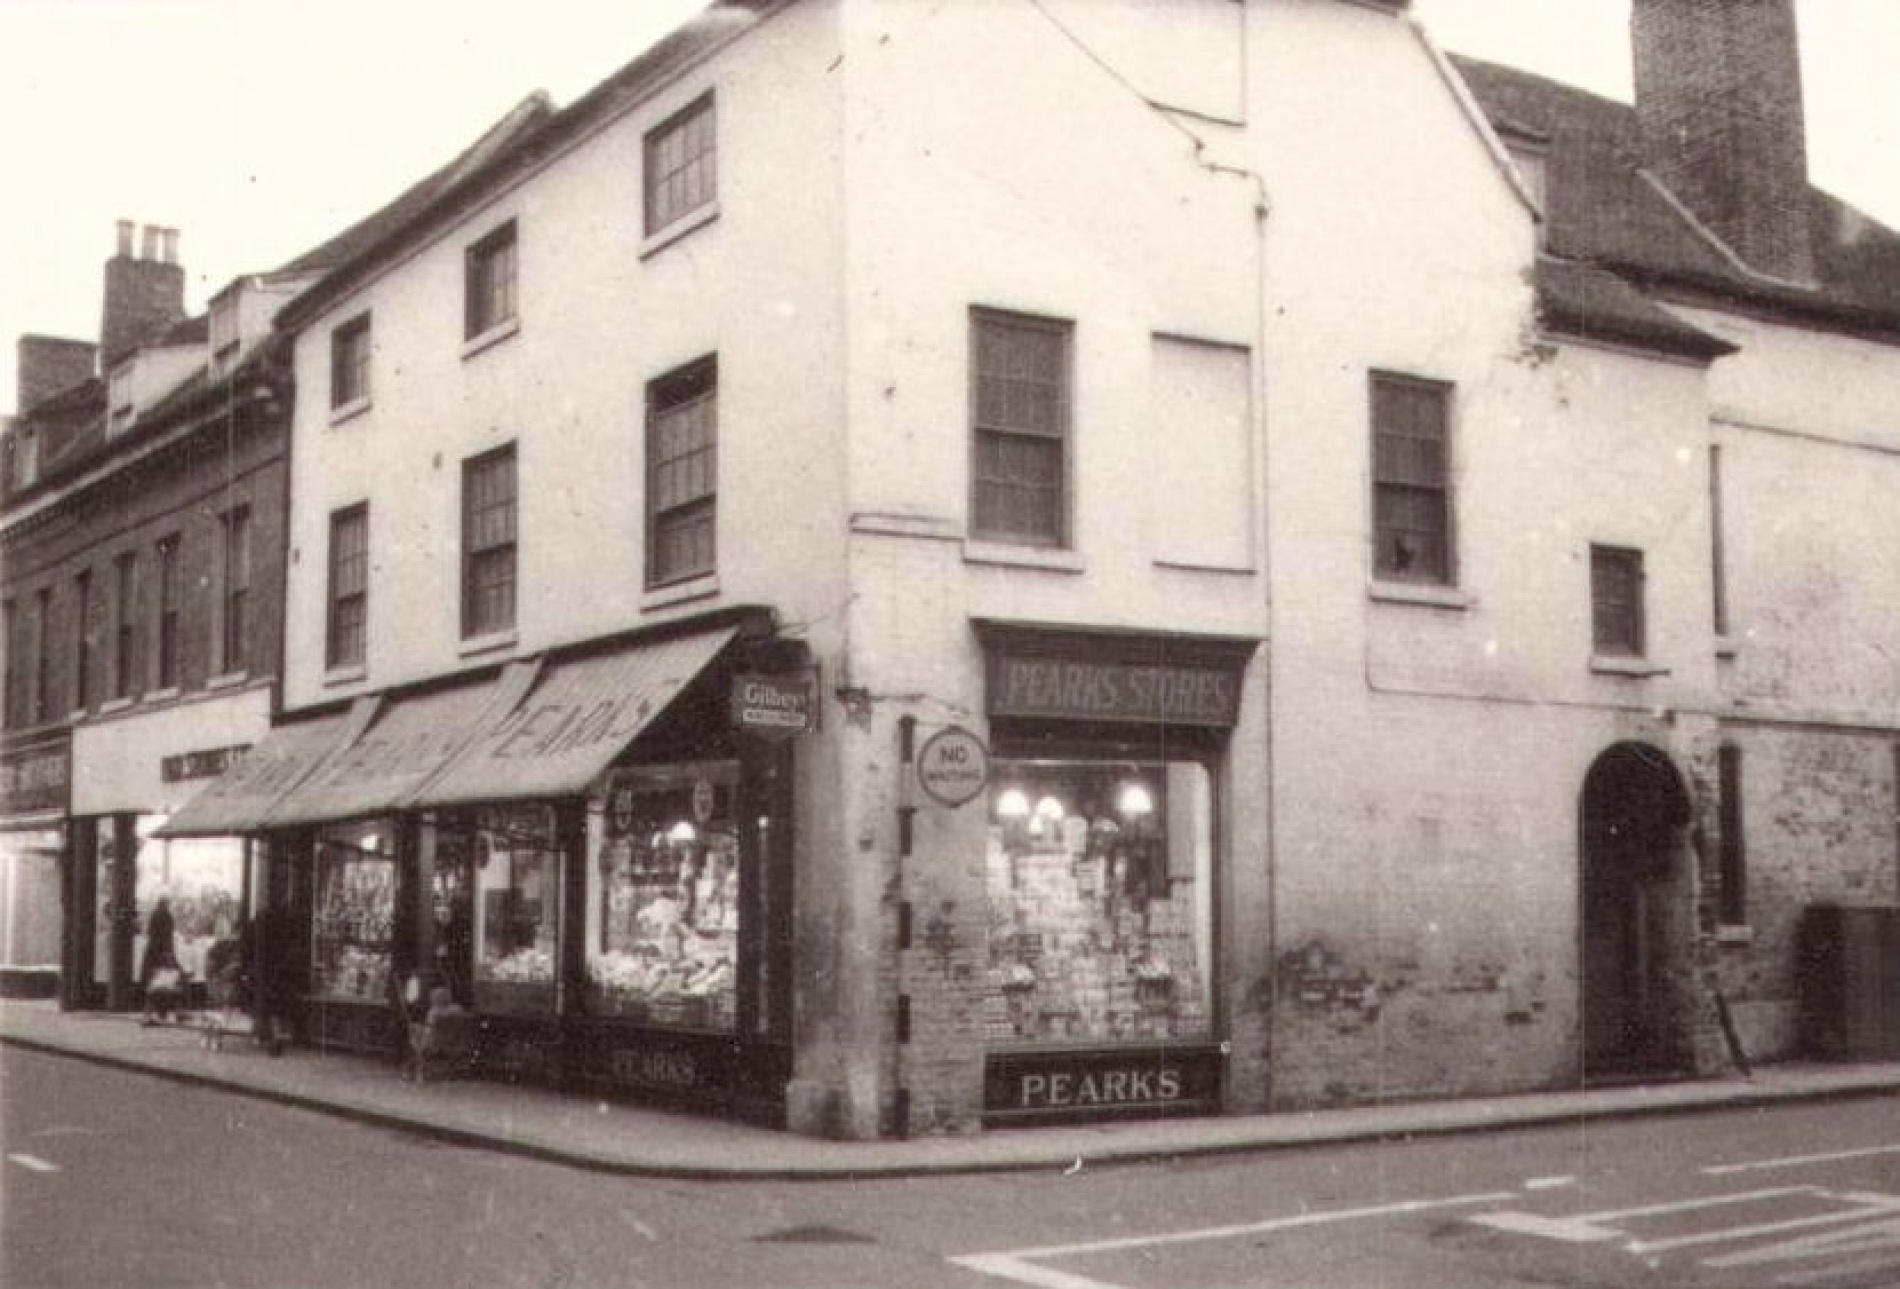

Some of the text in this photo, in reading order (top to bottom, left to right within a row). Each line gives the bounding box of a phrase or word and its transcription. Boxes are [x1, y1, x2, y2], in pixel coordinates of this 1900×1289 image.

[1006, 662, 1119, 709] PEARKS
[940, 744, 969, 764] NO
[1020, 1068, 1181, 1107] PEARKS
